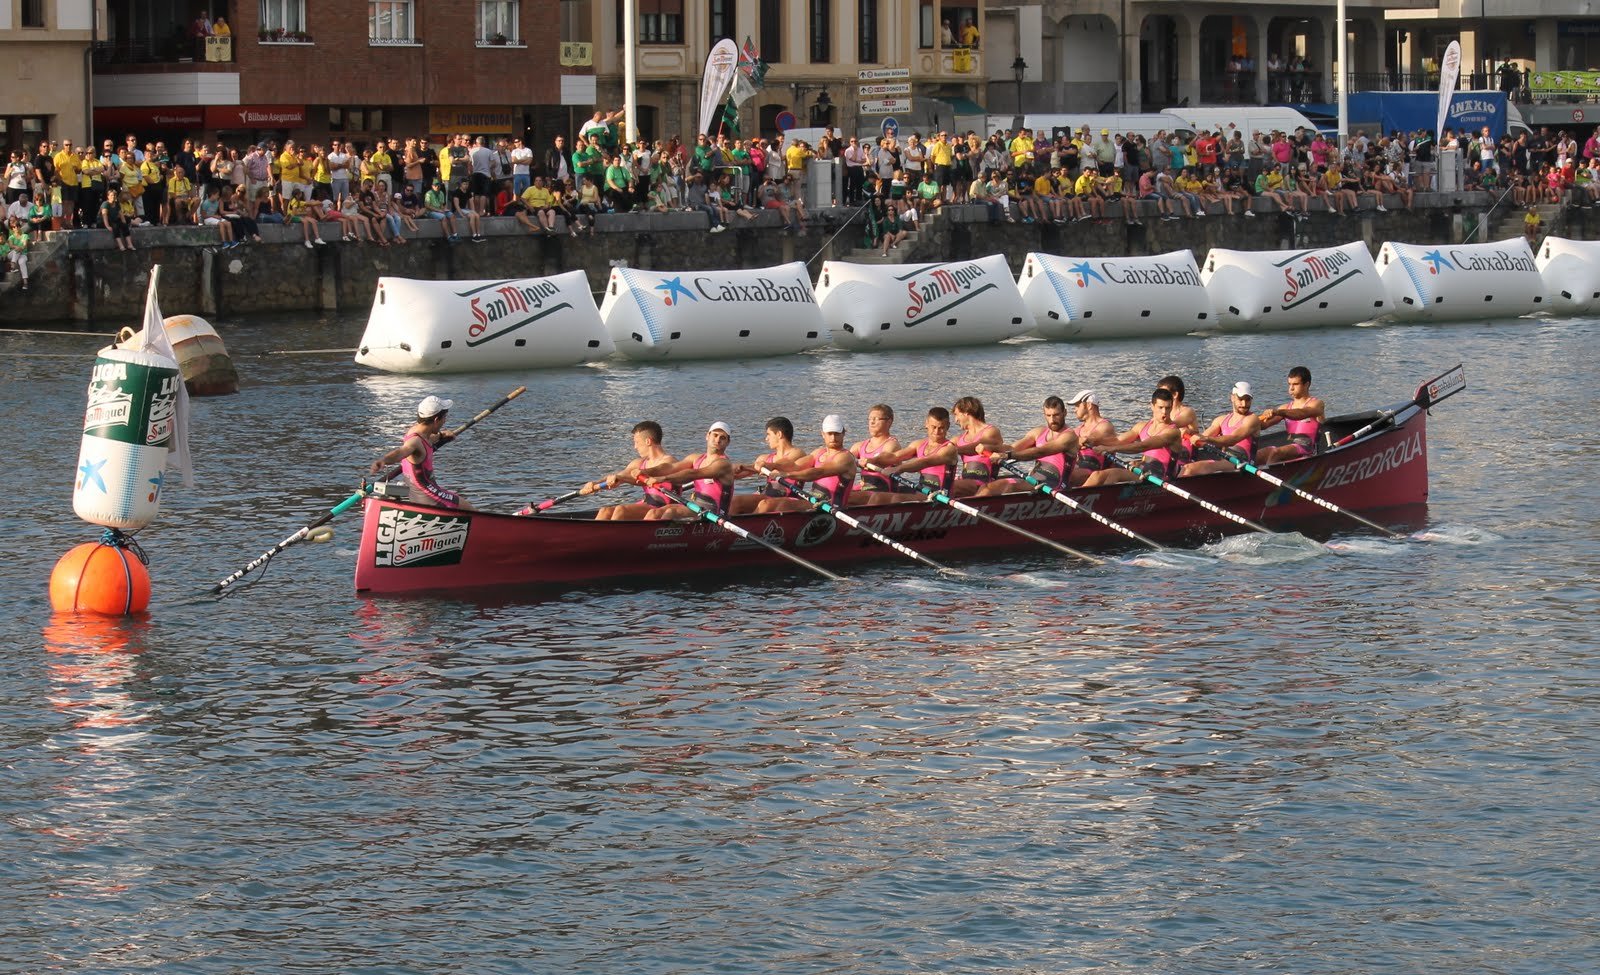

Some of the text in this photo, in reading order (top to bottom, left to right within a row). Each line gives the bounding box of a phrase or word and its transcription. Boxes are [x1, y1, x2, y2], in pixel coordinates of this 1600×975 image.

[247, 112, 302, 123] Bilbao Aseguruak
[694, 277, 815, 304] CaixaBank
[1317, 431, 1423, 490] IBERDROLA
[376, 509, 398, 566] LIGA
